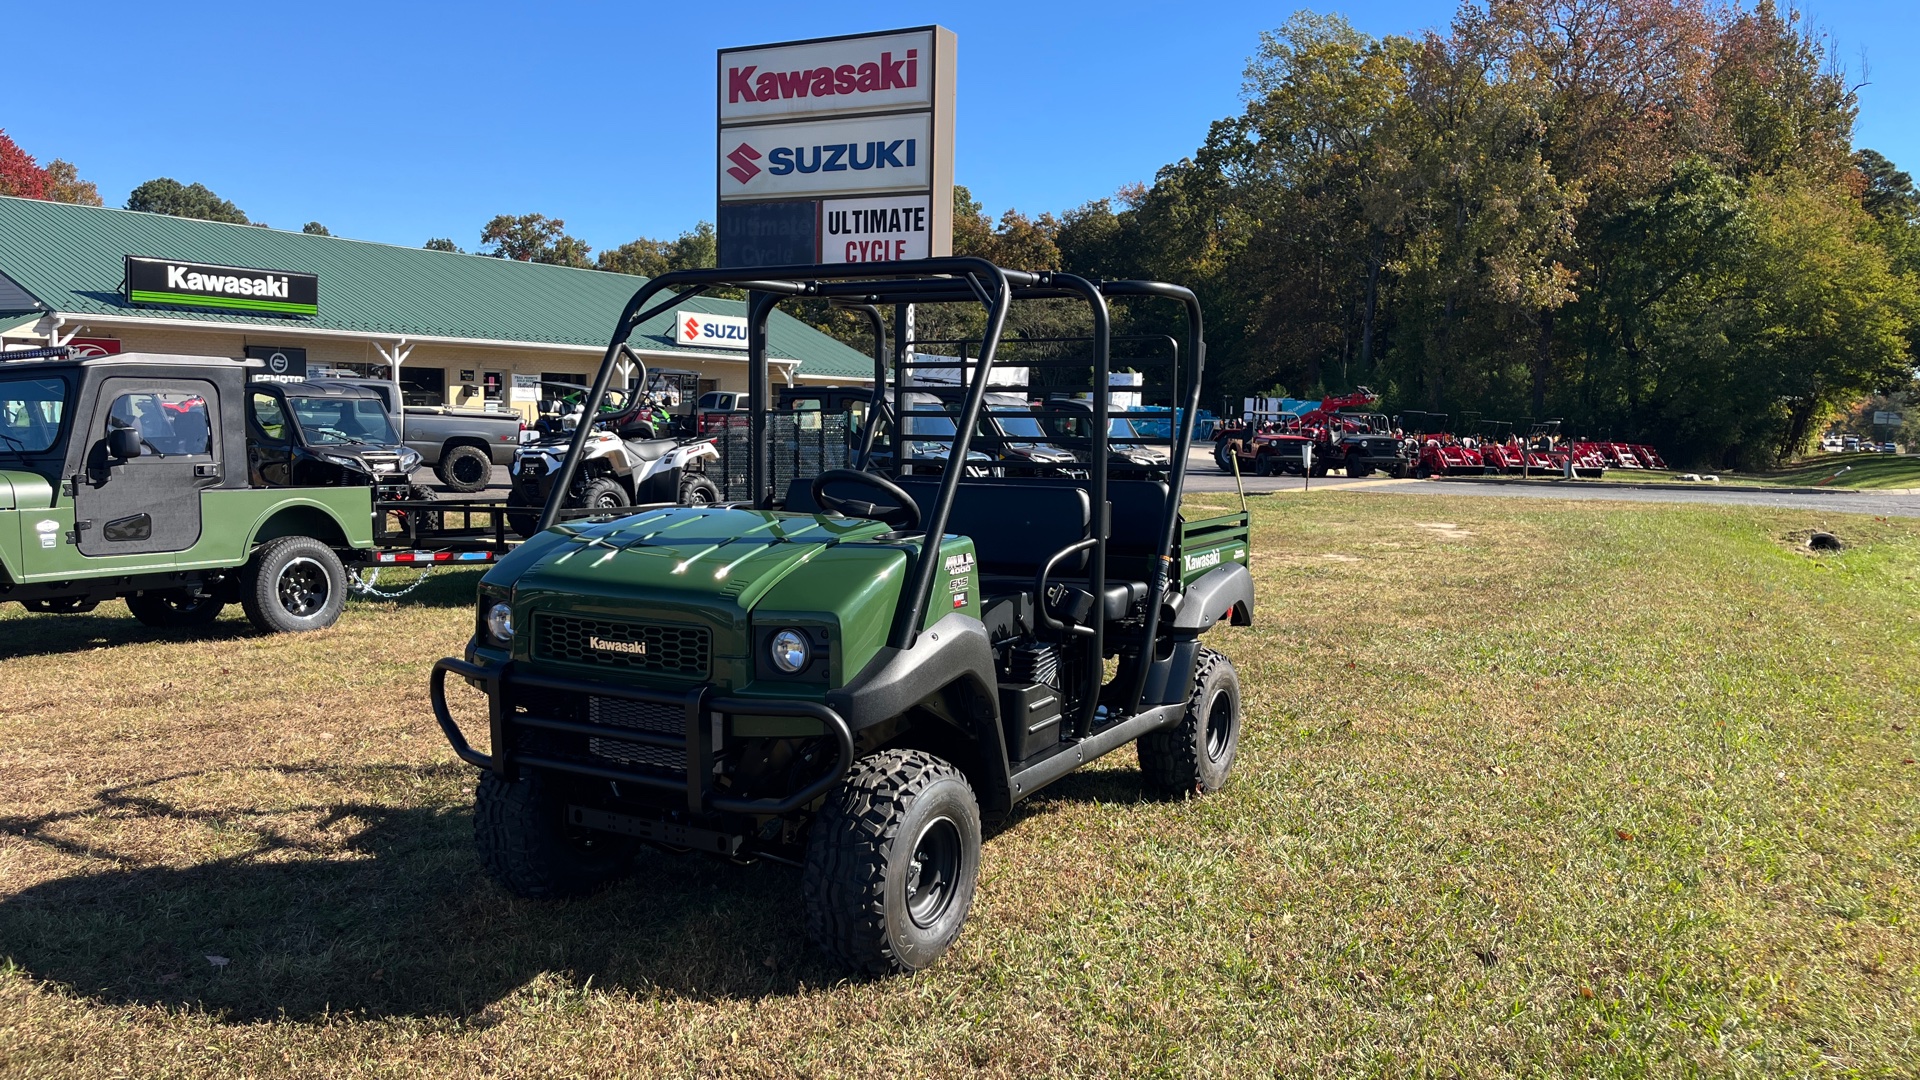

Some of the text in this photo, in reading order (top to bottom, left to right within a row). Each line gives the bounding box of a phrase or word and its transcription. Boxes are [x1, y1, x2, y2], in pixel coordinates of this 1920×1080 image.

[729, 49, 917, 103] Kawasaki
[768, 139, 916, 175] SUZUKI
[828, 207, 925, 235] ULTIMATE
[845, 240, 907, 263] CYCLE
[167, 265, 288, 298] Kawasaki
[703, 323, 748, 340] SUZU
[944, 553, 975, 570] MULE
[950, 565, 971, 575] 4000
[1184, 548, 1220, 571] Kawasaki
[590, 636, 646, 654] Kawasaki
